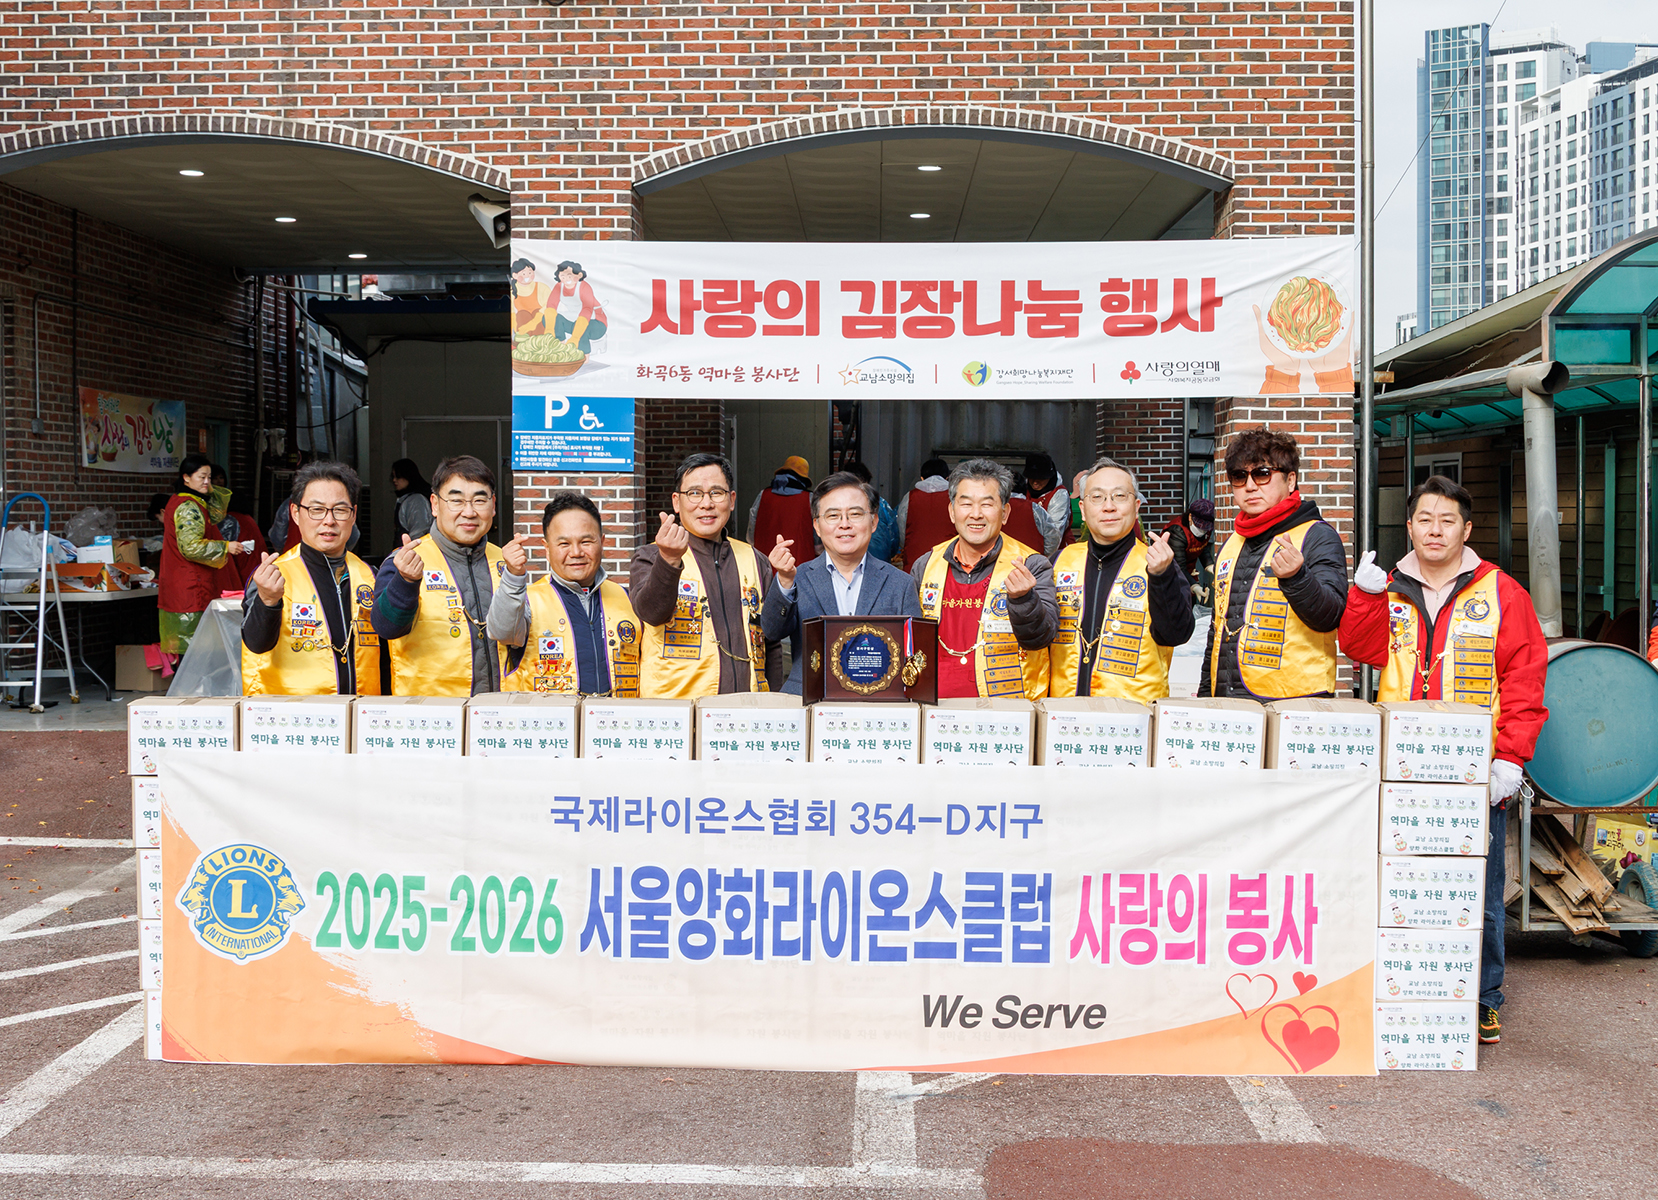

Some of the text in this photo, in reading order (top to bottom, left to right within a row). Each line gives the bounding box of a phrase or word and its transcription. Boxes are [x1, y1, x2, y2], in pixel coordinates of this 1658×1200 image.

[640, 277, 1223, 339] 사랑의 김장나눔 행사
[636, 363, 801, 383] 화곡6동 역마을 봉사단
[1145, 360, 1220, 377] 사랑의열매
[860, 372, 915, 384] 교남소망의집
[545, 395, 570, 429] P
[137, 736, 229, 749] 역마을 자원 봉사단
[250, 733, 341, 747] 역마을 자원 봉사단
[365, 736, 457, 749] 역마을 자원 봉사단
[477, 737, 569, 749] 역마을 자원 봉사단
[592, 737, 684, 750] 역마을 자원 봉사단
[709, 739, 801, 752] 역마을 자원 봉사단
[821, 738, 913, 751] 역마을 자원 봉사단
[1165, 737, 1256, 754] 역마을 자원 봉사단
[932, 741, 1024, 754] 역마을 자원 봉사단
[1053, 742, 1143, 756] 역마을 자원 봉사단
[1286, 742, 1375, 756] 역마을 자원 봉사단
[1395, 742, 1485, 757] 역마을 자원 봉사단
[550, 795, 1044, 839] 국제라이온스협회 354-D지구
[1390, 815, 1480, 829] 역마을 자원 봉사단
[209, 848, 278, 873] LIONS
[227, 879, 259, 918] L
[1388, 888, 1478, 901] 역마을 자원 봉사단
[315, 865, 1318, 966] 2025-2026 서울양화라이온스클럽 사랑의 봉사
[206, 927, 279, 950] INTERNATIONAL
[1383, 960, 1474, 973] 역마을 자원 봉사단
[922, 993, 1107, 1031] We Serve
[1380, 1032, 1471, 1044] 역마을 자원 봉사단
